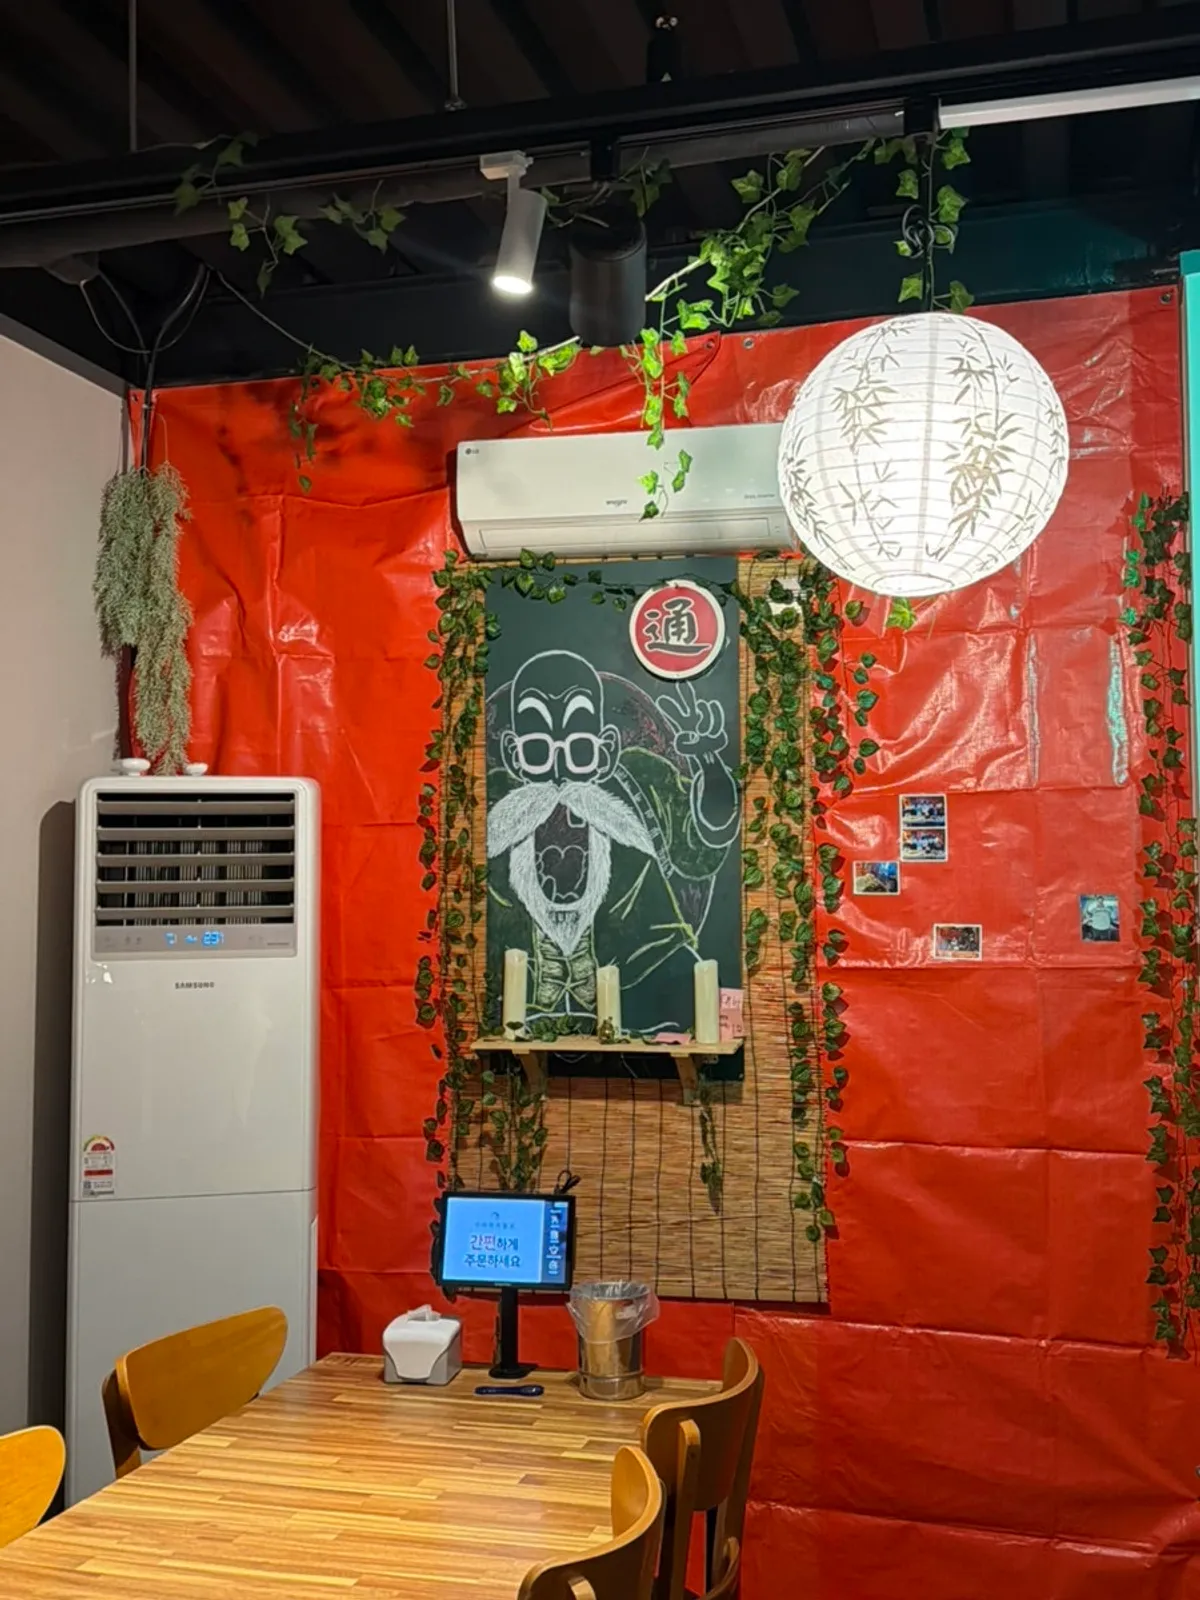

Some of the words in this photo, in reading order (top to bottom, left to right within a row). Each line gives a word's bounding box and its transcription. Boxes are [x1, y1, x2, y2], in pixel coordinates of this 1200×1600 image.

[643, 597, 712, 656] 通
[175, 981, 215, 990] SAMSUNG
[469, 1234, 519, 1252] 간편하게
[464, 1253, 521, 1268] 주문하세요
